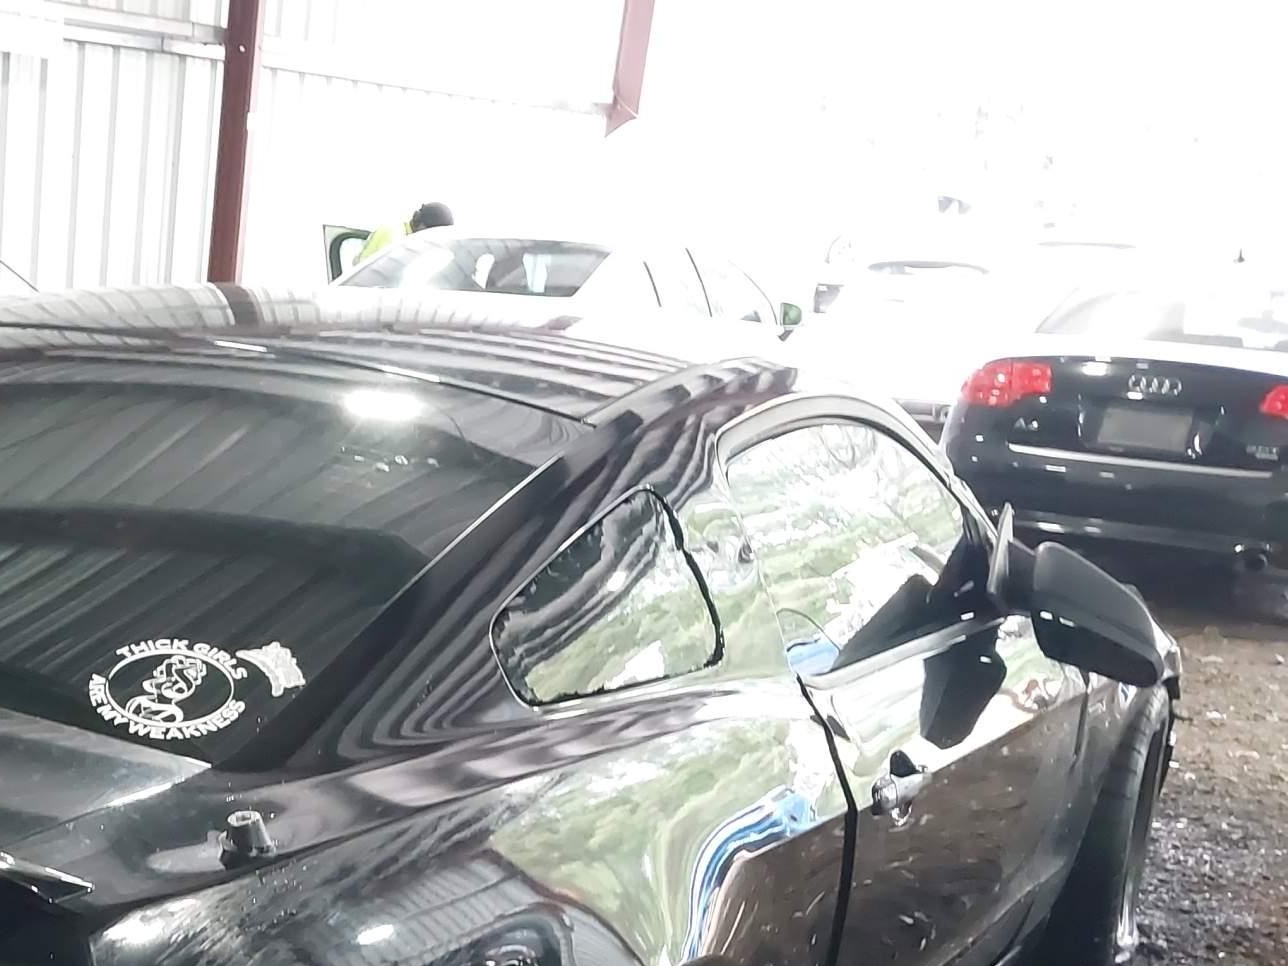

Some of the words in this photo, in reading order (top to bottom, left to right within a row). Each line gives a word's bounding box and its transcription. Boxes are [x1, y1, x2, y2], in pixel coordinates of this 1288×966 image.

[116, 638, 189, 656] THICK
[193, 643, 248, 680] GIRLS
[88, 673, 109, 707] ARE
[96, 704, 129, 726] MY
[128, 699, 246, 740] WEAKNESS
